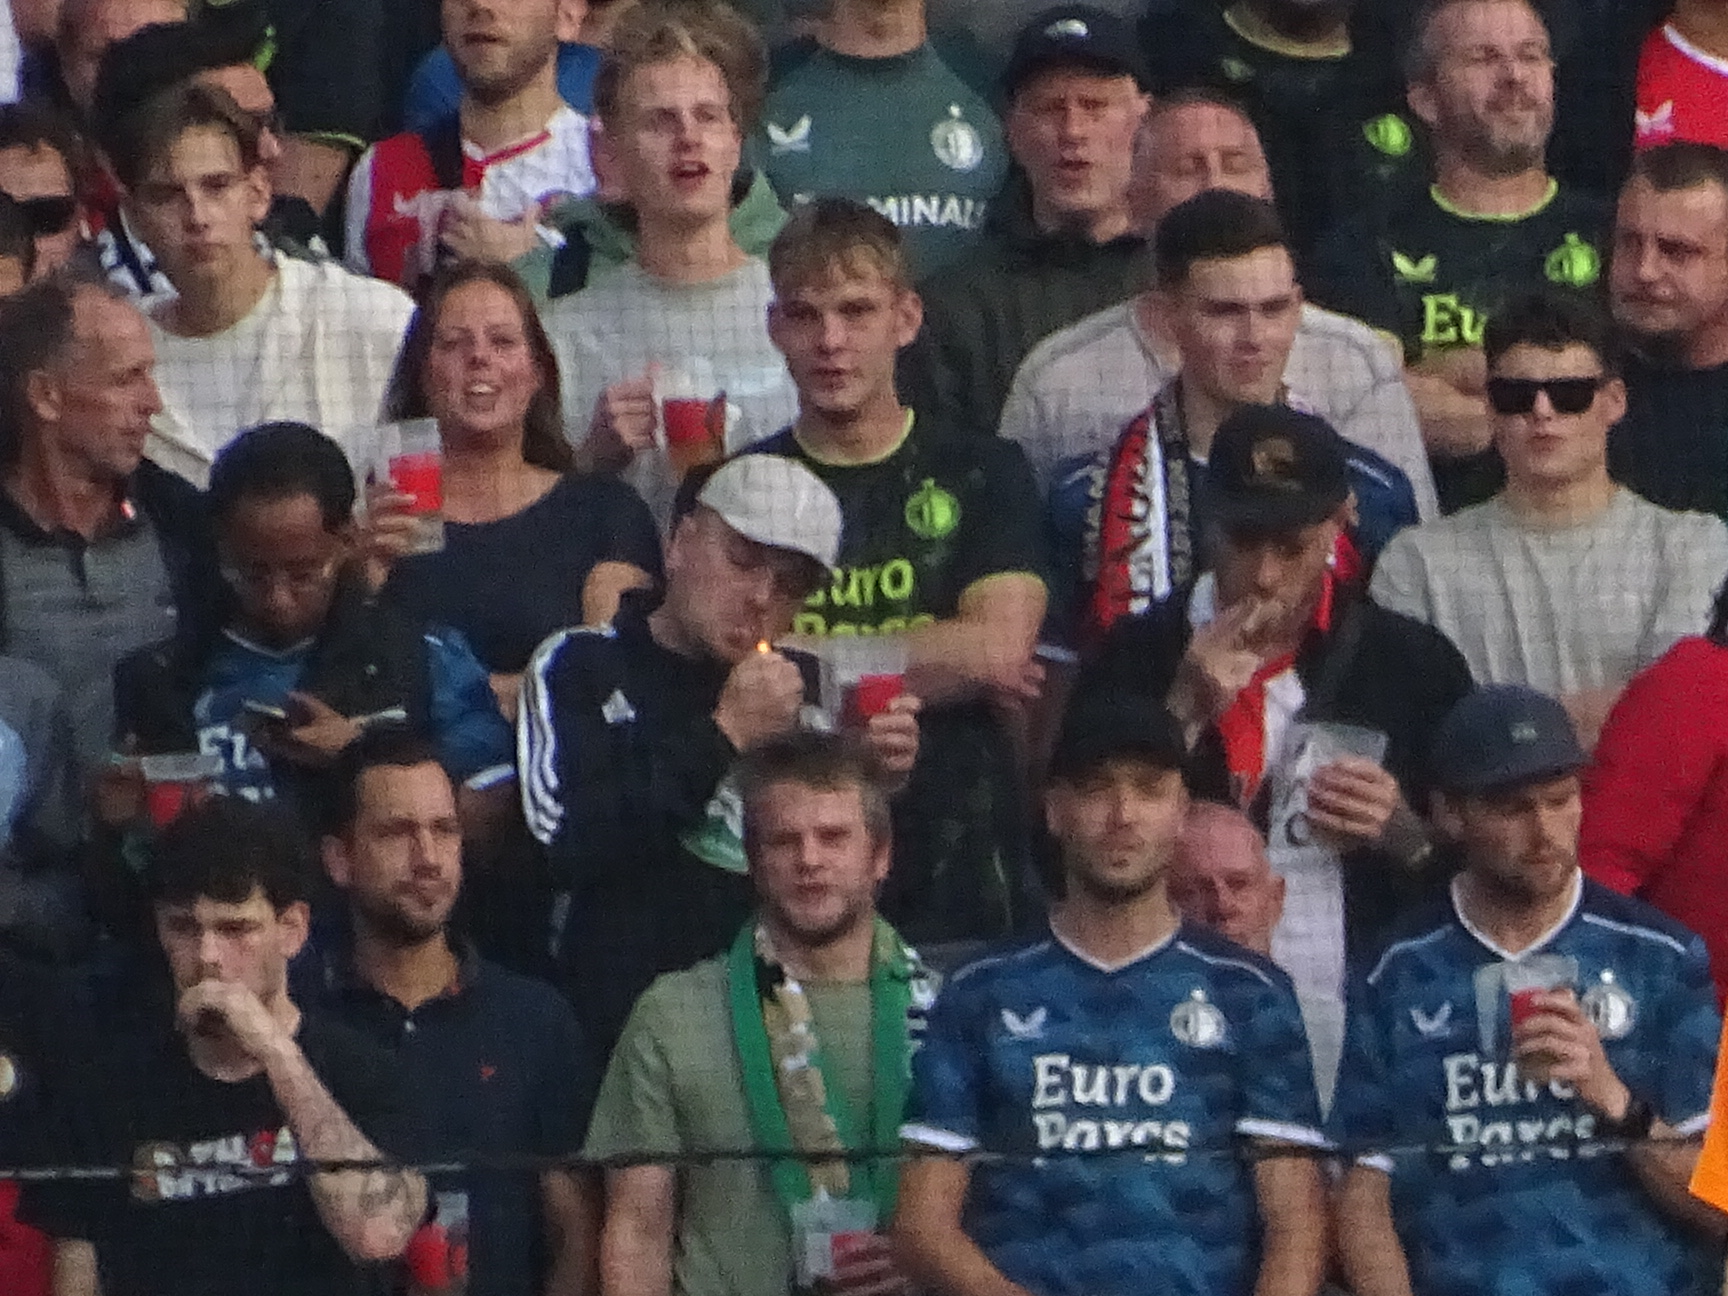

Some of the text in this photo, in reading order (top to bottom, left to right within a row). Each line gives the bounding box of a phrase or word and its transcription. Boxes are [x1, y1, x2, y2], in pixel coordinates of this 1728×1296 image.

[804, 557, 914, 608] uro
[1032, 1053, 1176, 1110] Euro
[1032, 1111, 1192, 1169] Parcs
